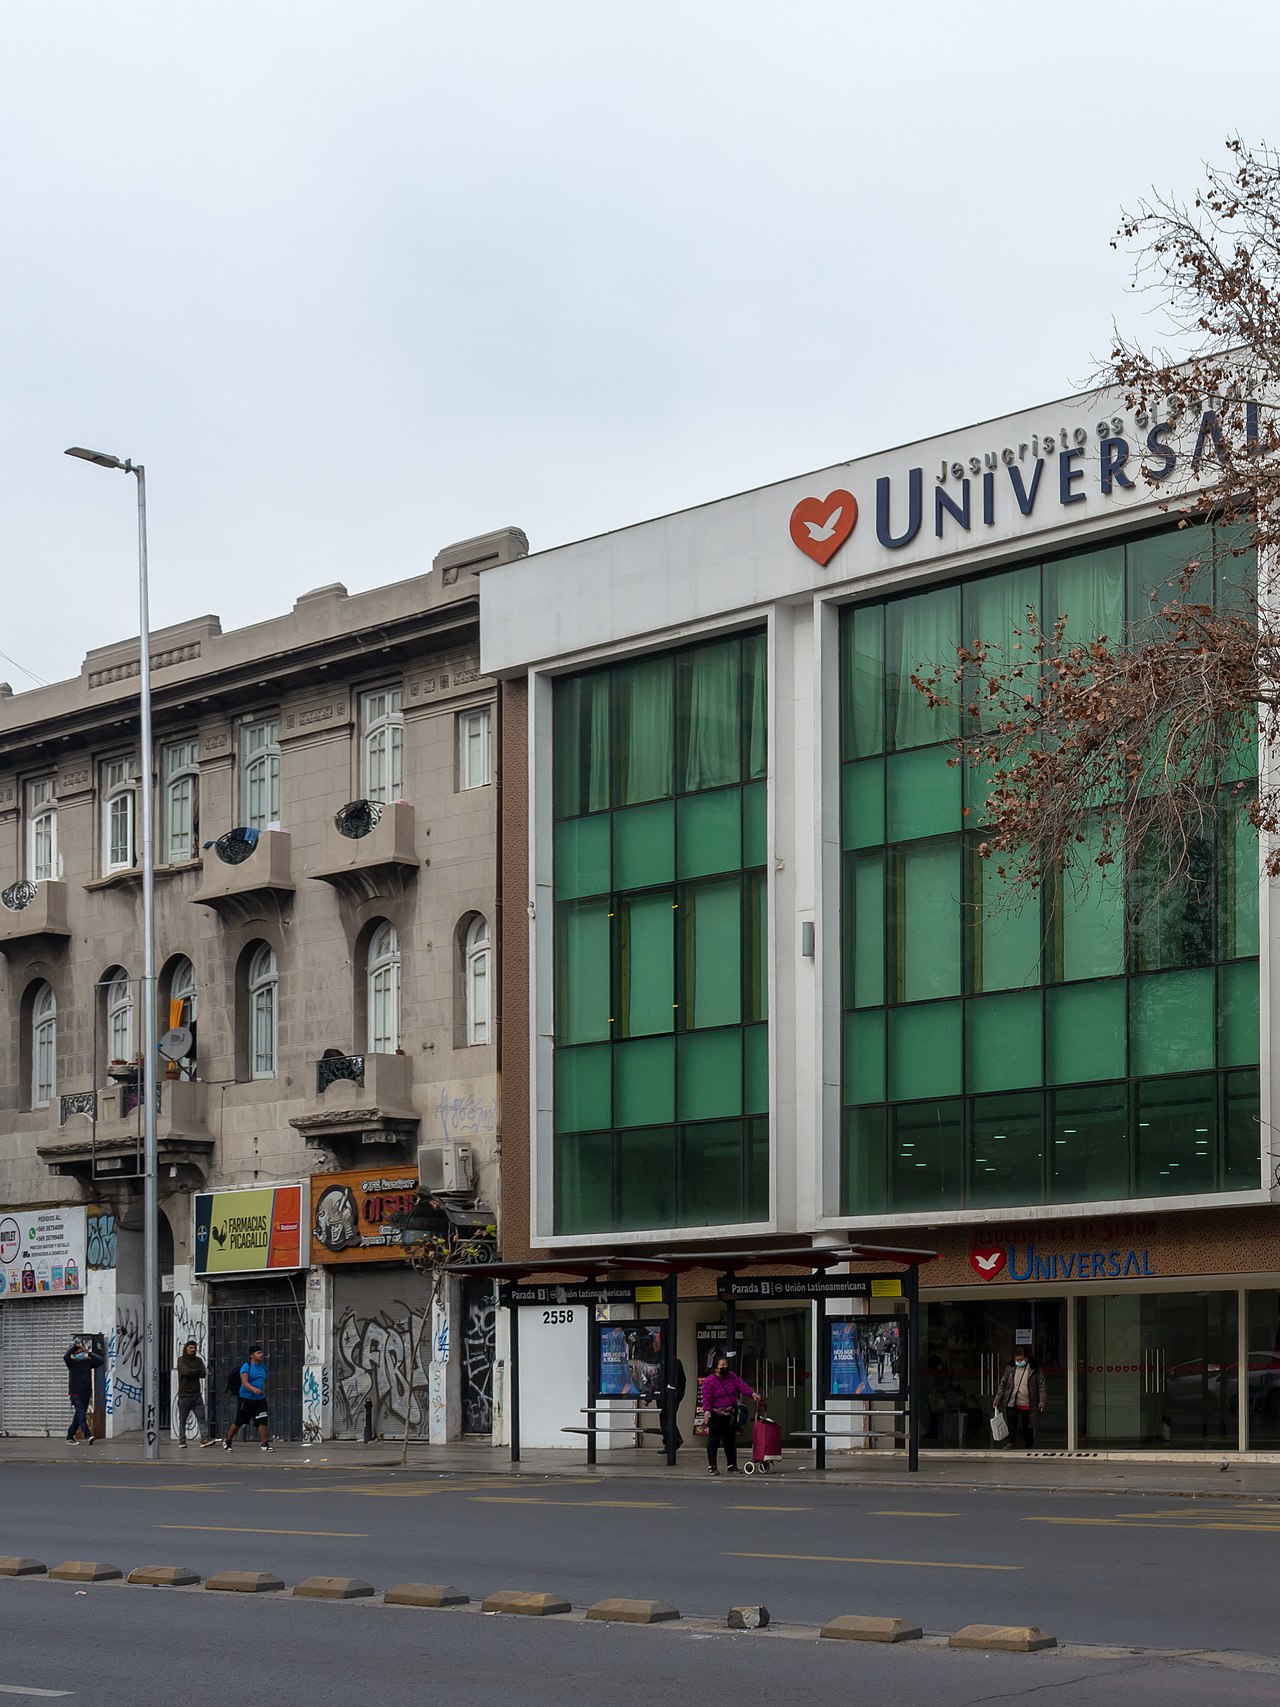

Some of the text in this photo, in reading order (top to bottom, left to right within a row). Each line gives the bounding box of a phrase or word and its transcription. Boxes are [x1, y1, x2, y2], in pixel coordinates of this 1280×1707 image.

[936, 427, 1087, 482] Jesucristo
[1096, 415, 1123, 438] es
[1134, 401, 1157, 428] el
[228, 1215, 267, 1233] FARMACIAS
[230, 1231, 268, 1250] PICAGALLO
[1008, 1243, 1155, 1281] UNIVERSAL
[511, 1290, 536, 1299] Parada
[731, 1283, 759, 1293] Parada
[785, 1282, 806, 1292] Unión
[807, 1281, 867, 1292] Latinoamericana
[543, 1310, 574, 1324] 2558
[697, 1331, 710, 1339] CURA
